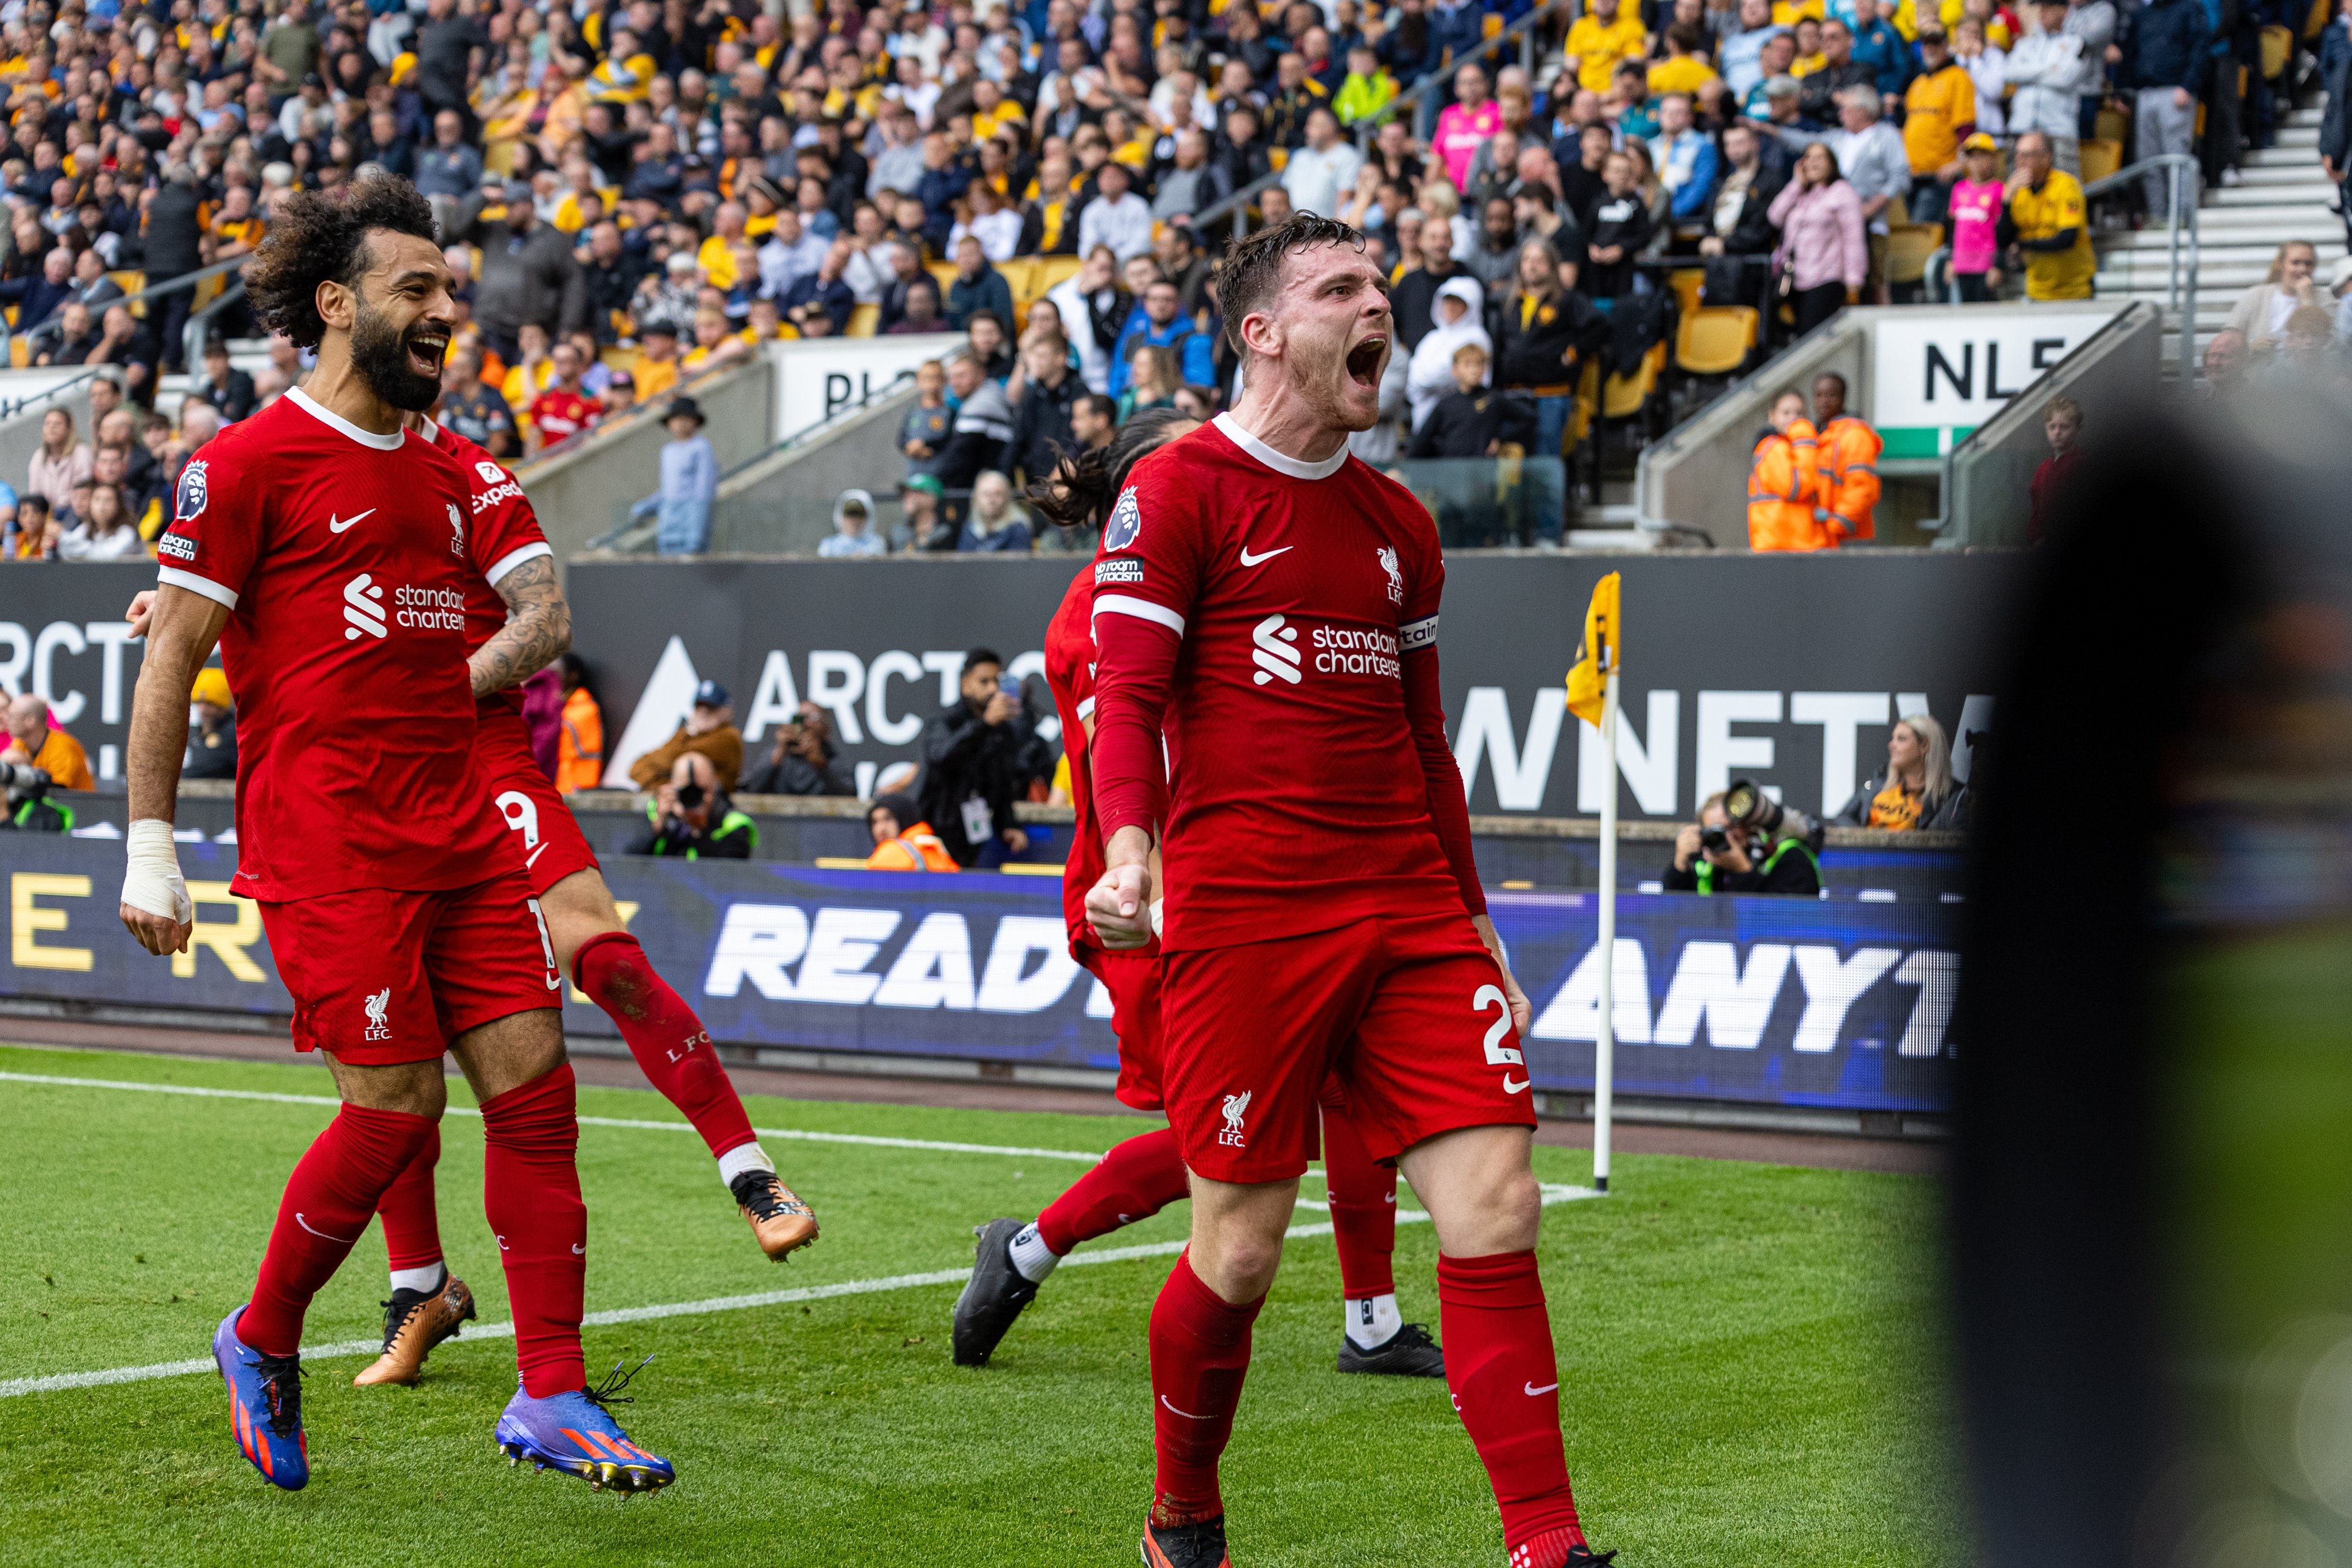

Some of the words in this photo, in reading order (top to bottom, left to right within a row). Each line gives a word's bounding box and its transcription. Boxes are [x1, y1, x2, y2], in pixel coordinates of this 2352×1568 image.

[1102, 571, 1143, 582] racism
[1106, 560, 1138, 572] room
[496, 791, 539, 850] 9
[1473, 984, 1523, 1065] 2
[1530, 937, 1962, 1059] ANYT
